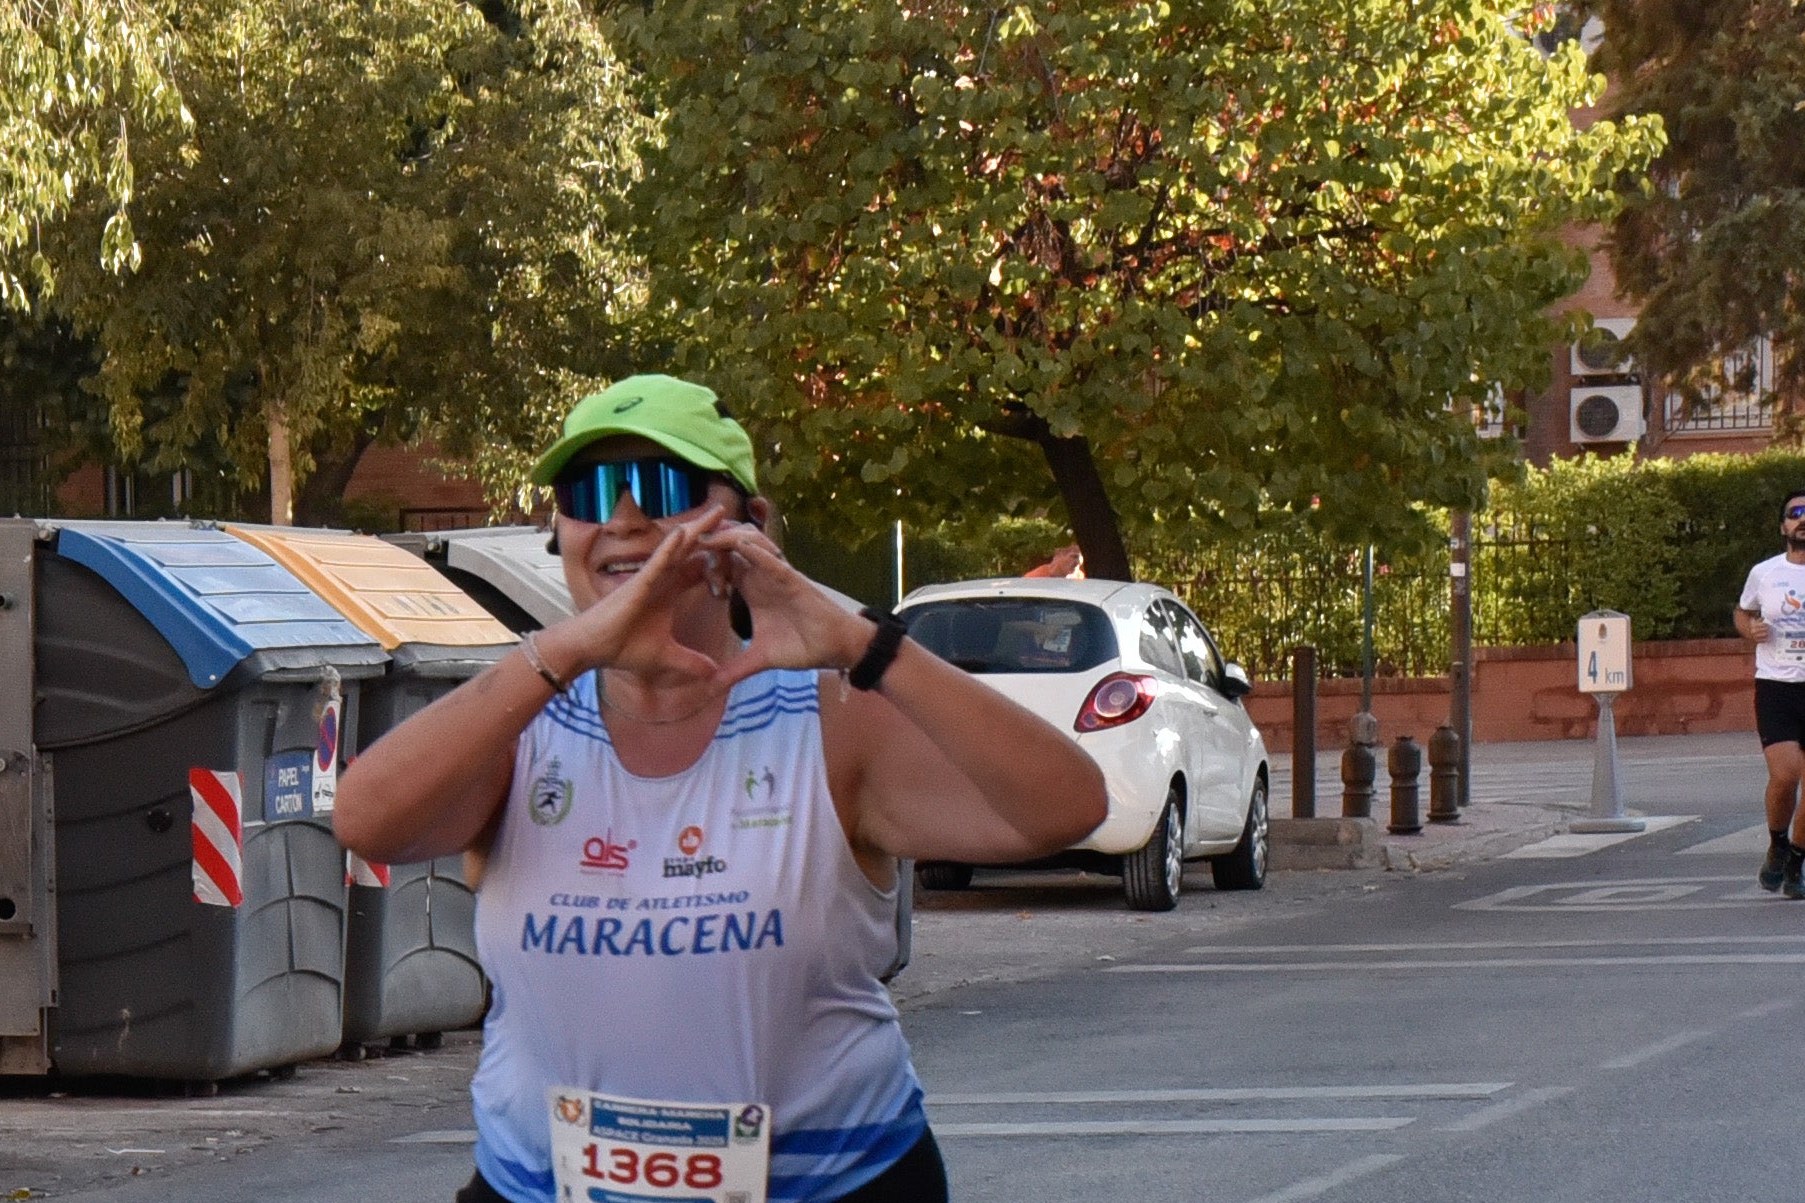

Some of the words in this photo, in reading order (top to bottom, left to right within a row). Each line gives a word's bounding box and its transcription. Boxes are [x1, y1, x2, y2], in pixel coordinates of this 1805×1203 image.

[1588, 651, 1598, 684] 4
[1605, 668, 1624, 684] km
[278, 767, 299, 787] PAPEL
[662, 856, 727, 879] mayfo
[550, 893, 600, 909] CLUB
[606, 897, 631, 911] DE
[635, 890, 750, 911] ATLETISMO
[521, 908, 784, 956] MARACENA
[582, 1143, 724, 1189] 1368
